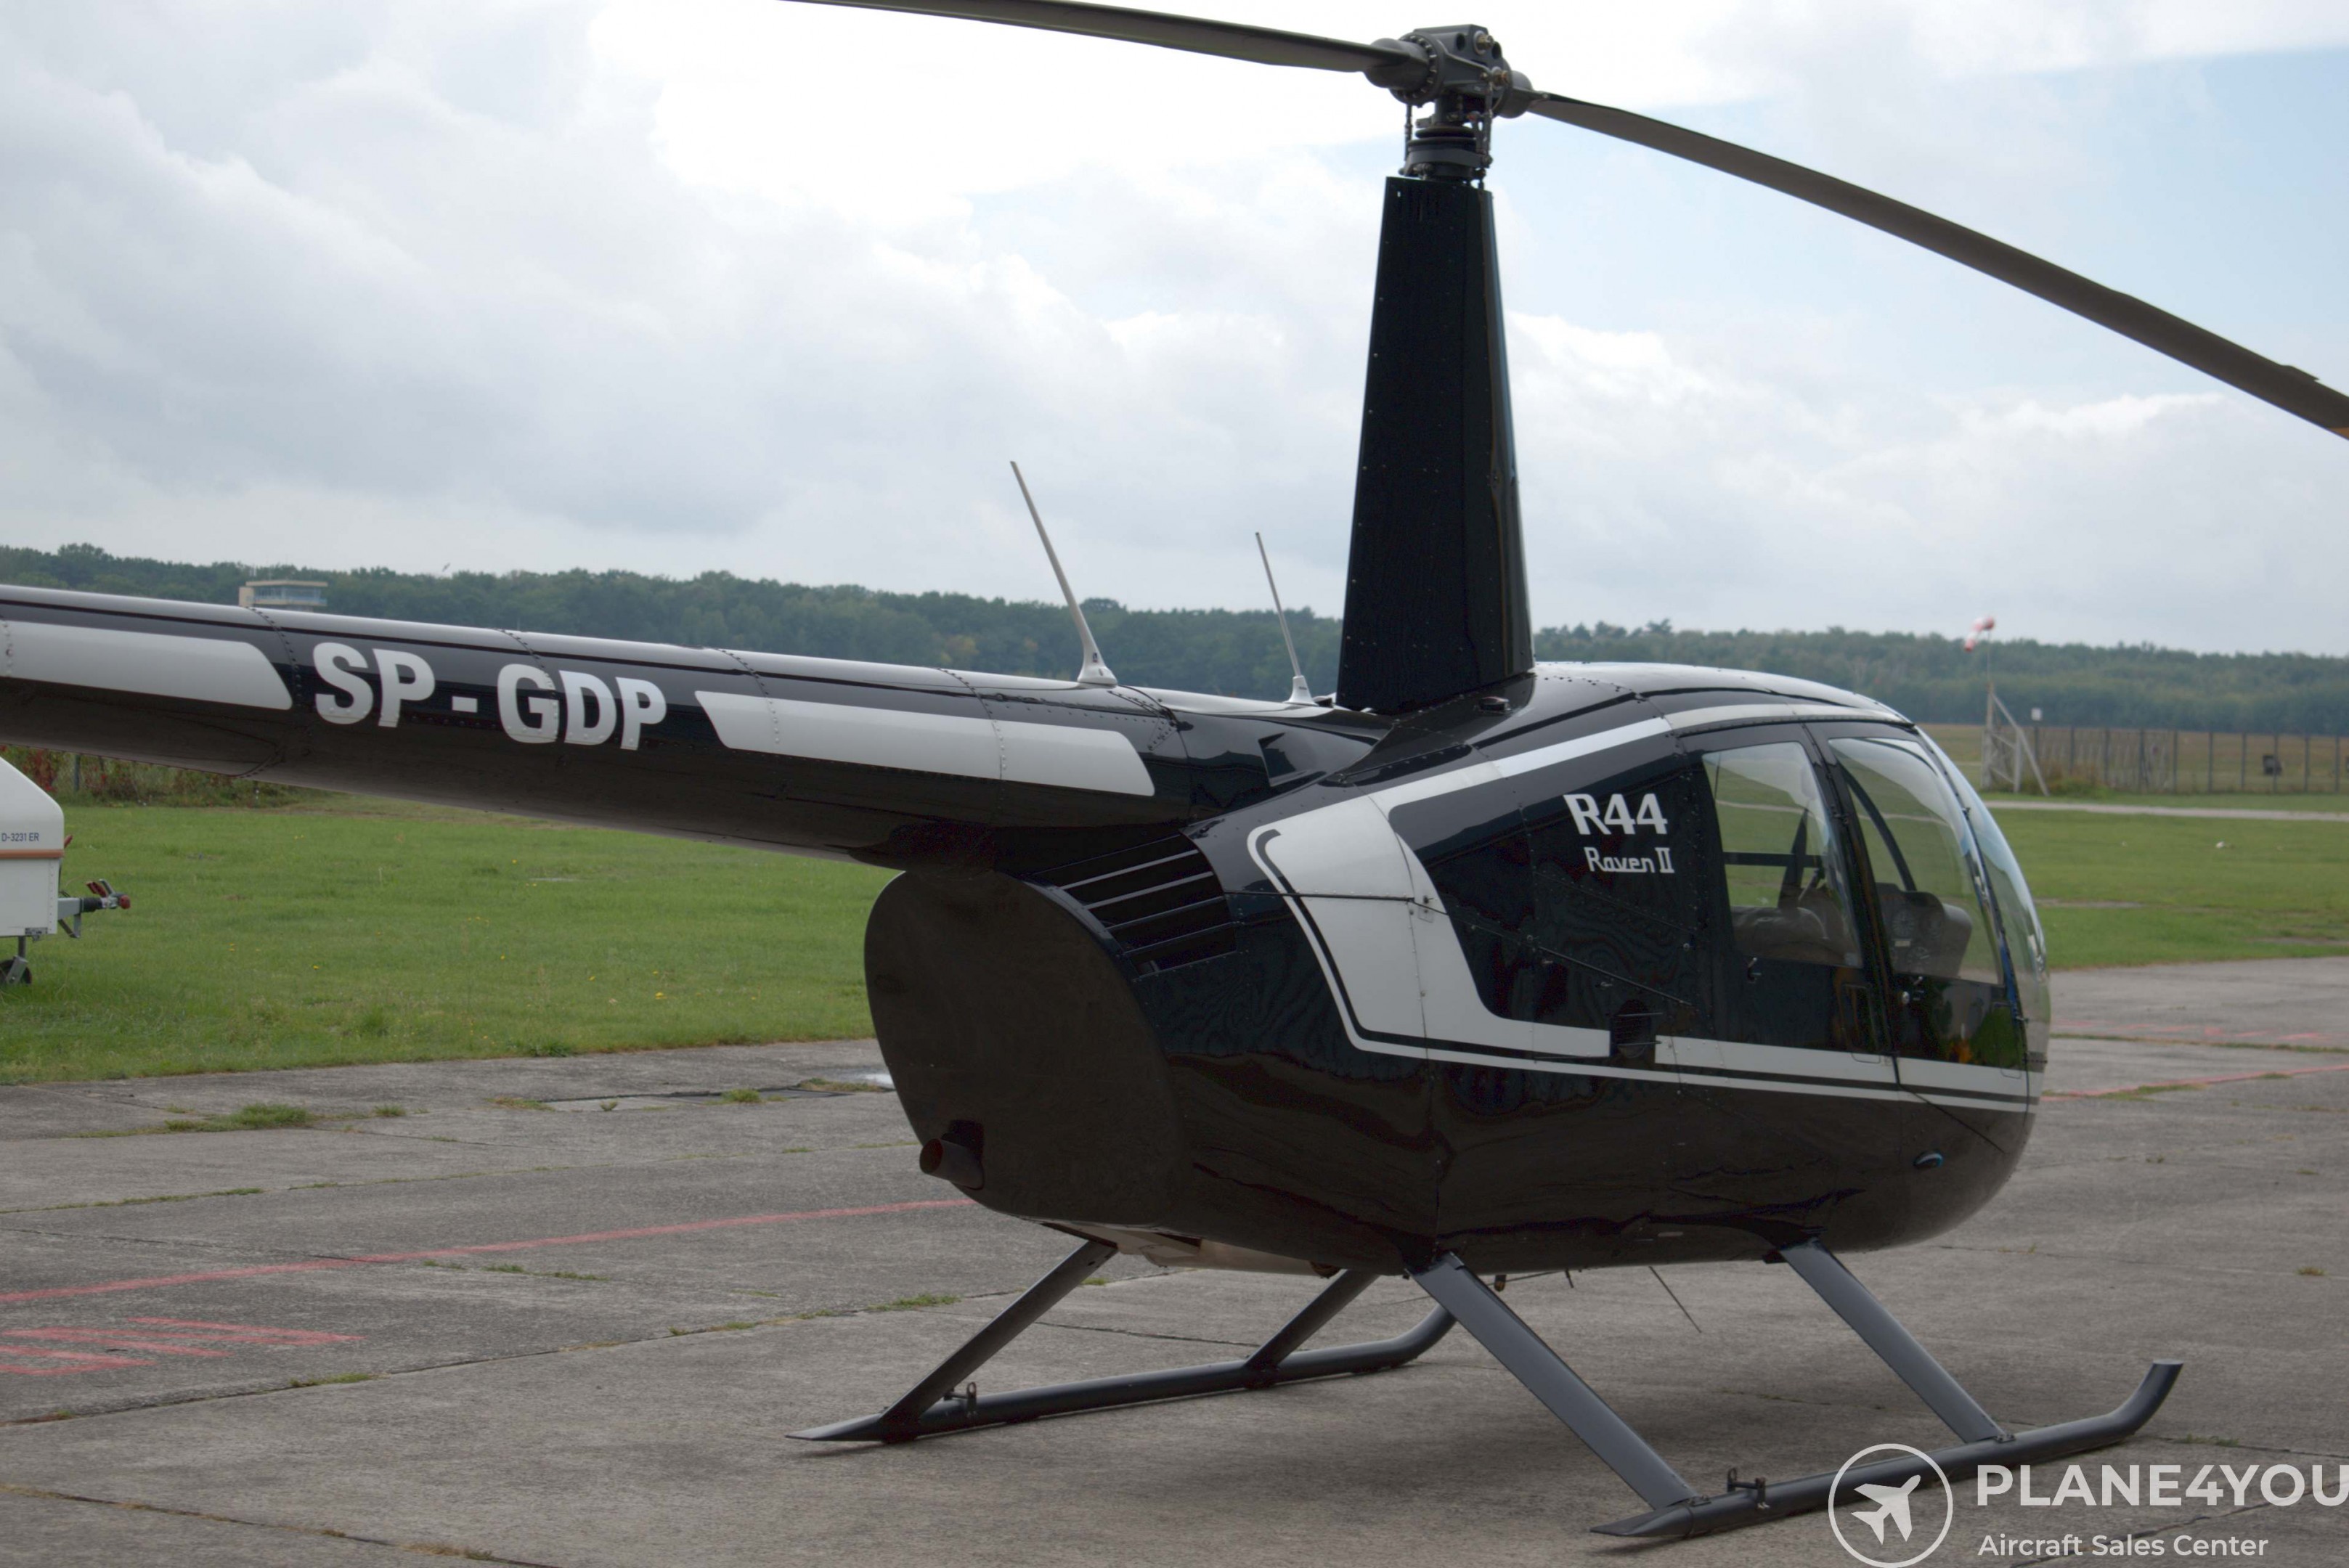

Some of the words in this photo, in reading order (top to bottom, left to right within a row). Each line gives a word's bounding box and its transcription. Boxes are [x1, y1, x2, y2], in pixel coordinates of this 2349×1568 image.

[1563, 793, 1668, 835] R44
[1, 833, 27, 842] D-3231
[29, 832, 40, 842] ER
[1584, 846, 1655, 873] Raven
